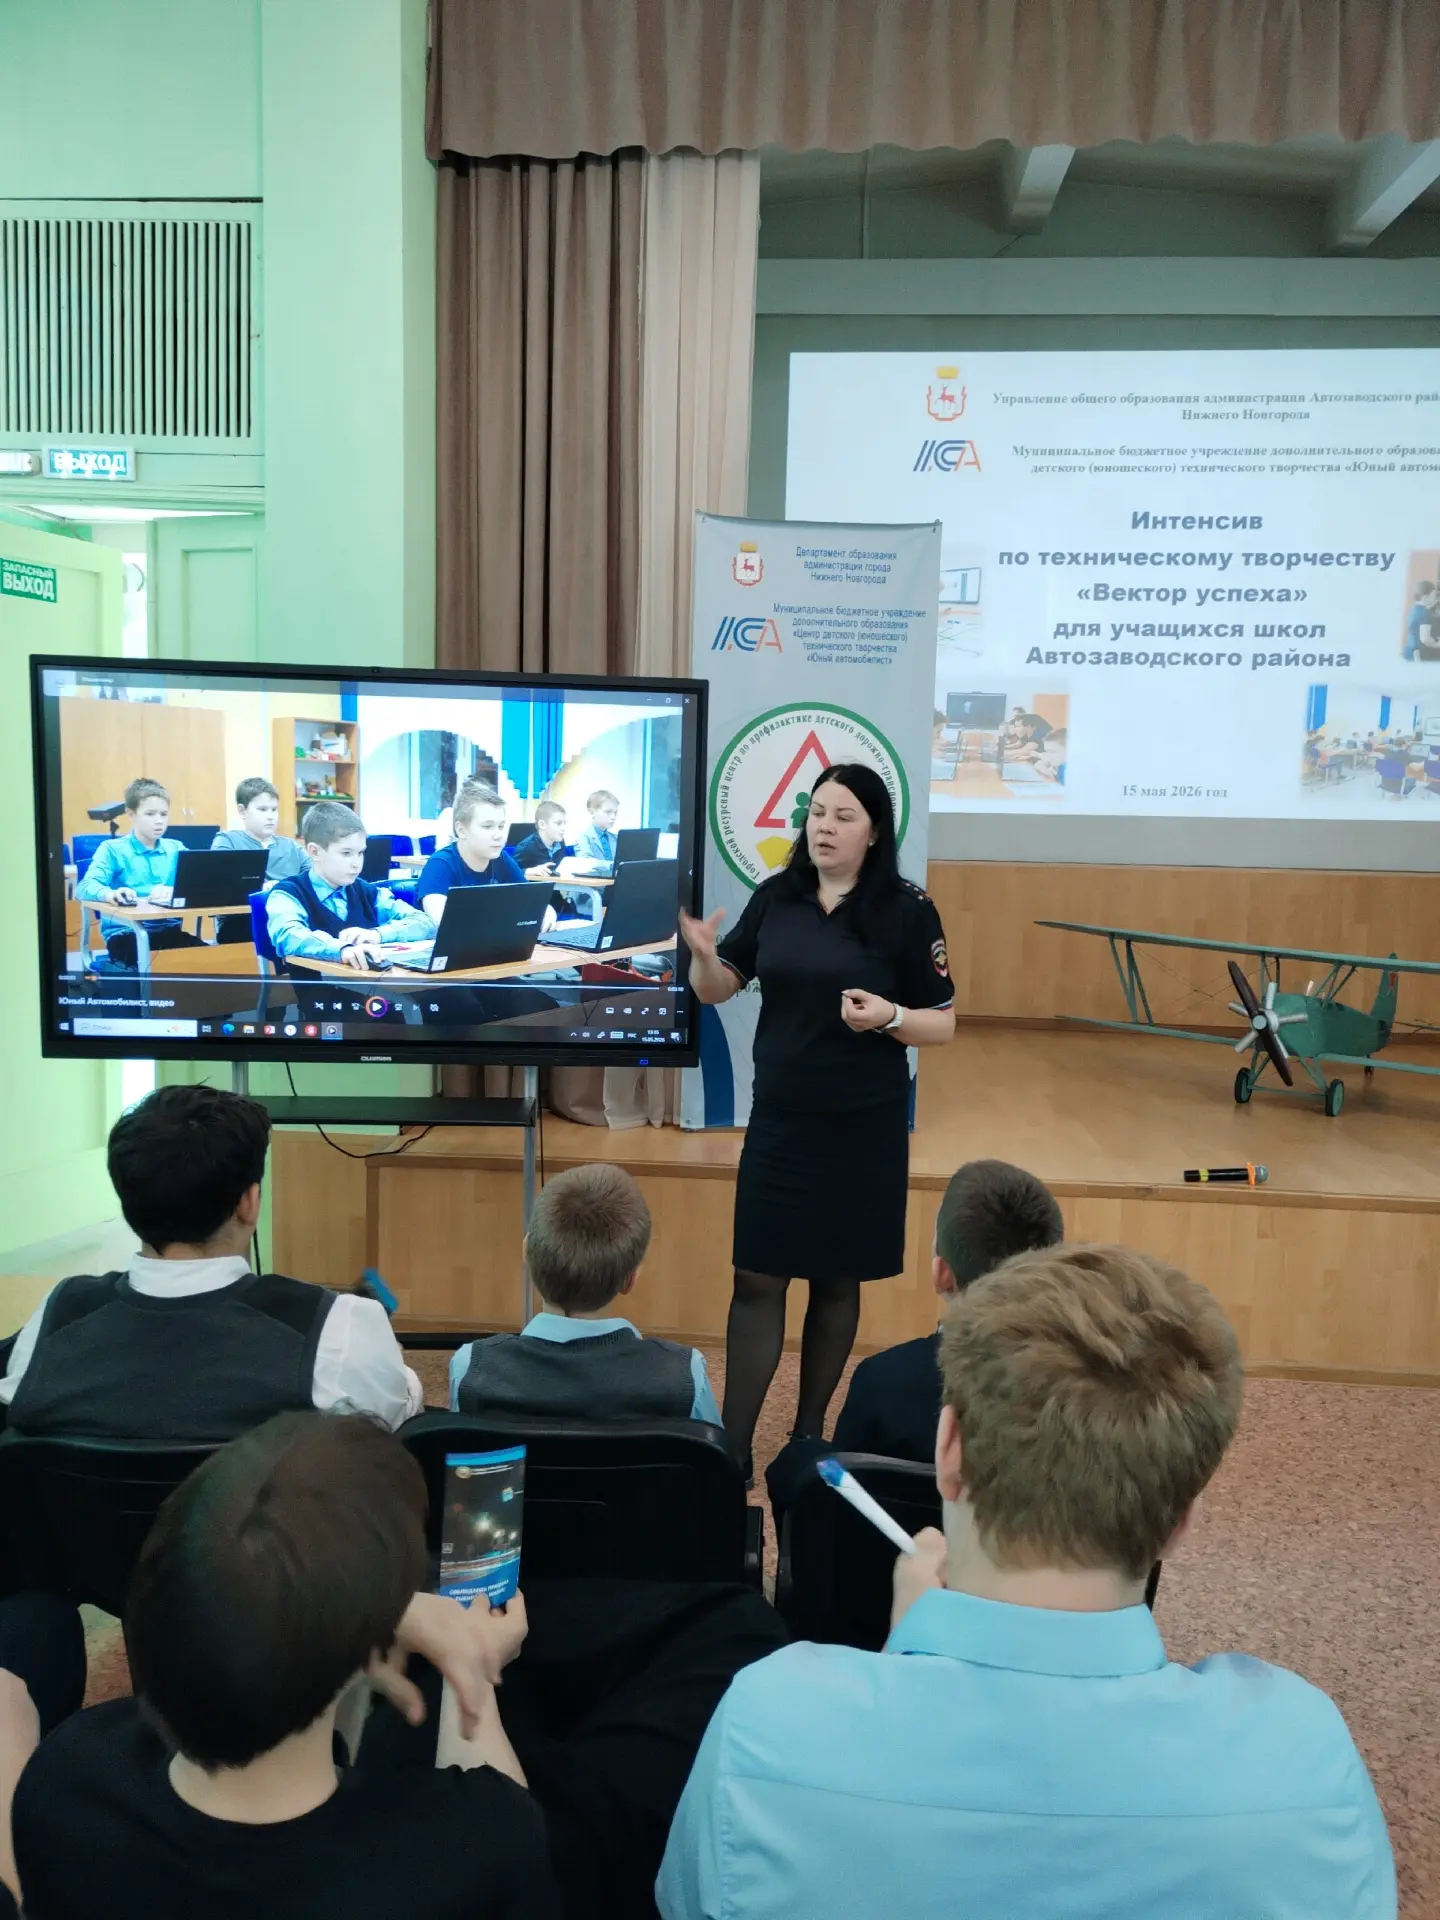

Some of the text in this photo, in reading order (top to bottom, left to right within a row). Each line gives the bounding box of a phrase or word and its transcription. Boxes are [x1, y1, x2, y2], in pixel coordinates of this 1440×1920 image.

[992, 393, 1068, 404] Управление
[1071, 394, 1117, 405] общего
[1120, 393, 1200, 404] образования
[1204, 392, 1305, 404] администрации
[1310, 391, 1412, 404] Автозаводского
[1182, 408, 1310, 422] Нижнего Новгорода
[1012, 445, 1116, 458] Муниципальное
[1119, 445, 1188, 458] бюджетное
[1191, 447, 1267, 458] учреждение
[1270, 446, 1383, 457] дополнительного
[54, 452, 126, 474] ВЫХОД
[1031, 463, 1086, 473] детского
[1089, 463, 1177, 474] (юношеского)
[1180, 462, 1265, 473] технического
[1269, 462, 1341, 474] творчества
[1345, 461, 1396, 473] «Юный
[1131, 511, 1263, 530] Интенсив
[796, 546, 897, 561] Департамент образования
[803, 559, 891, 573] администрации города
[998, 551, 1396, 572] по техническому творчеству
[3, 561, 54, 579] ЗАПАСНЫЙ
[2, 571, 55, 600] ВЫХОД
[811, 573, 886, 585] Нижнего Новгорода
[1077, 583, 1308, 606] «Вектор успеха»
[773, 602, 926, 618] Муниципальное бюджетное учреждение
[792, 617, 909, 630] дополнительного образования
[793, 629, 908, 643] «Центр детского (юношеского)
[1053, 623, 1327, 641] для учащихся школ
[802, 642, 898, 654] технического творчества
[806, 653, 893, 665] «Юный автомобилист»
[1025, 646, 1351, 670] Автозаводского района
[750, 714, 813, 744] профилактике
[815, 715, 854, 734] детского
[740, 743, 750, 755] по
[724, 756, 743, 781] центр
[1123, 785, 1228, 797] 15 мая 2026 год
[719, 784, 735, 836] ресурсный
[725, 837, 761, 880] Городской
[58, 997, 86, 1005] Юный
